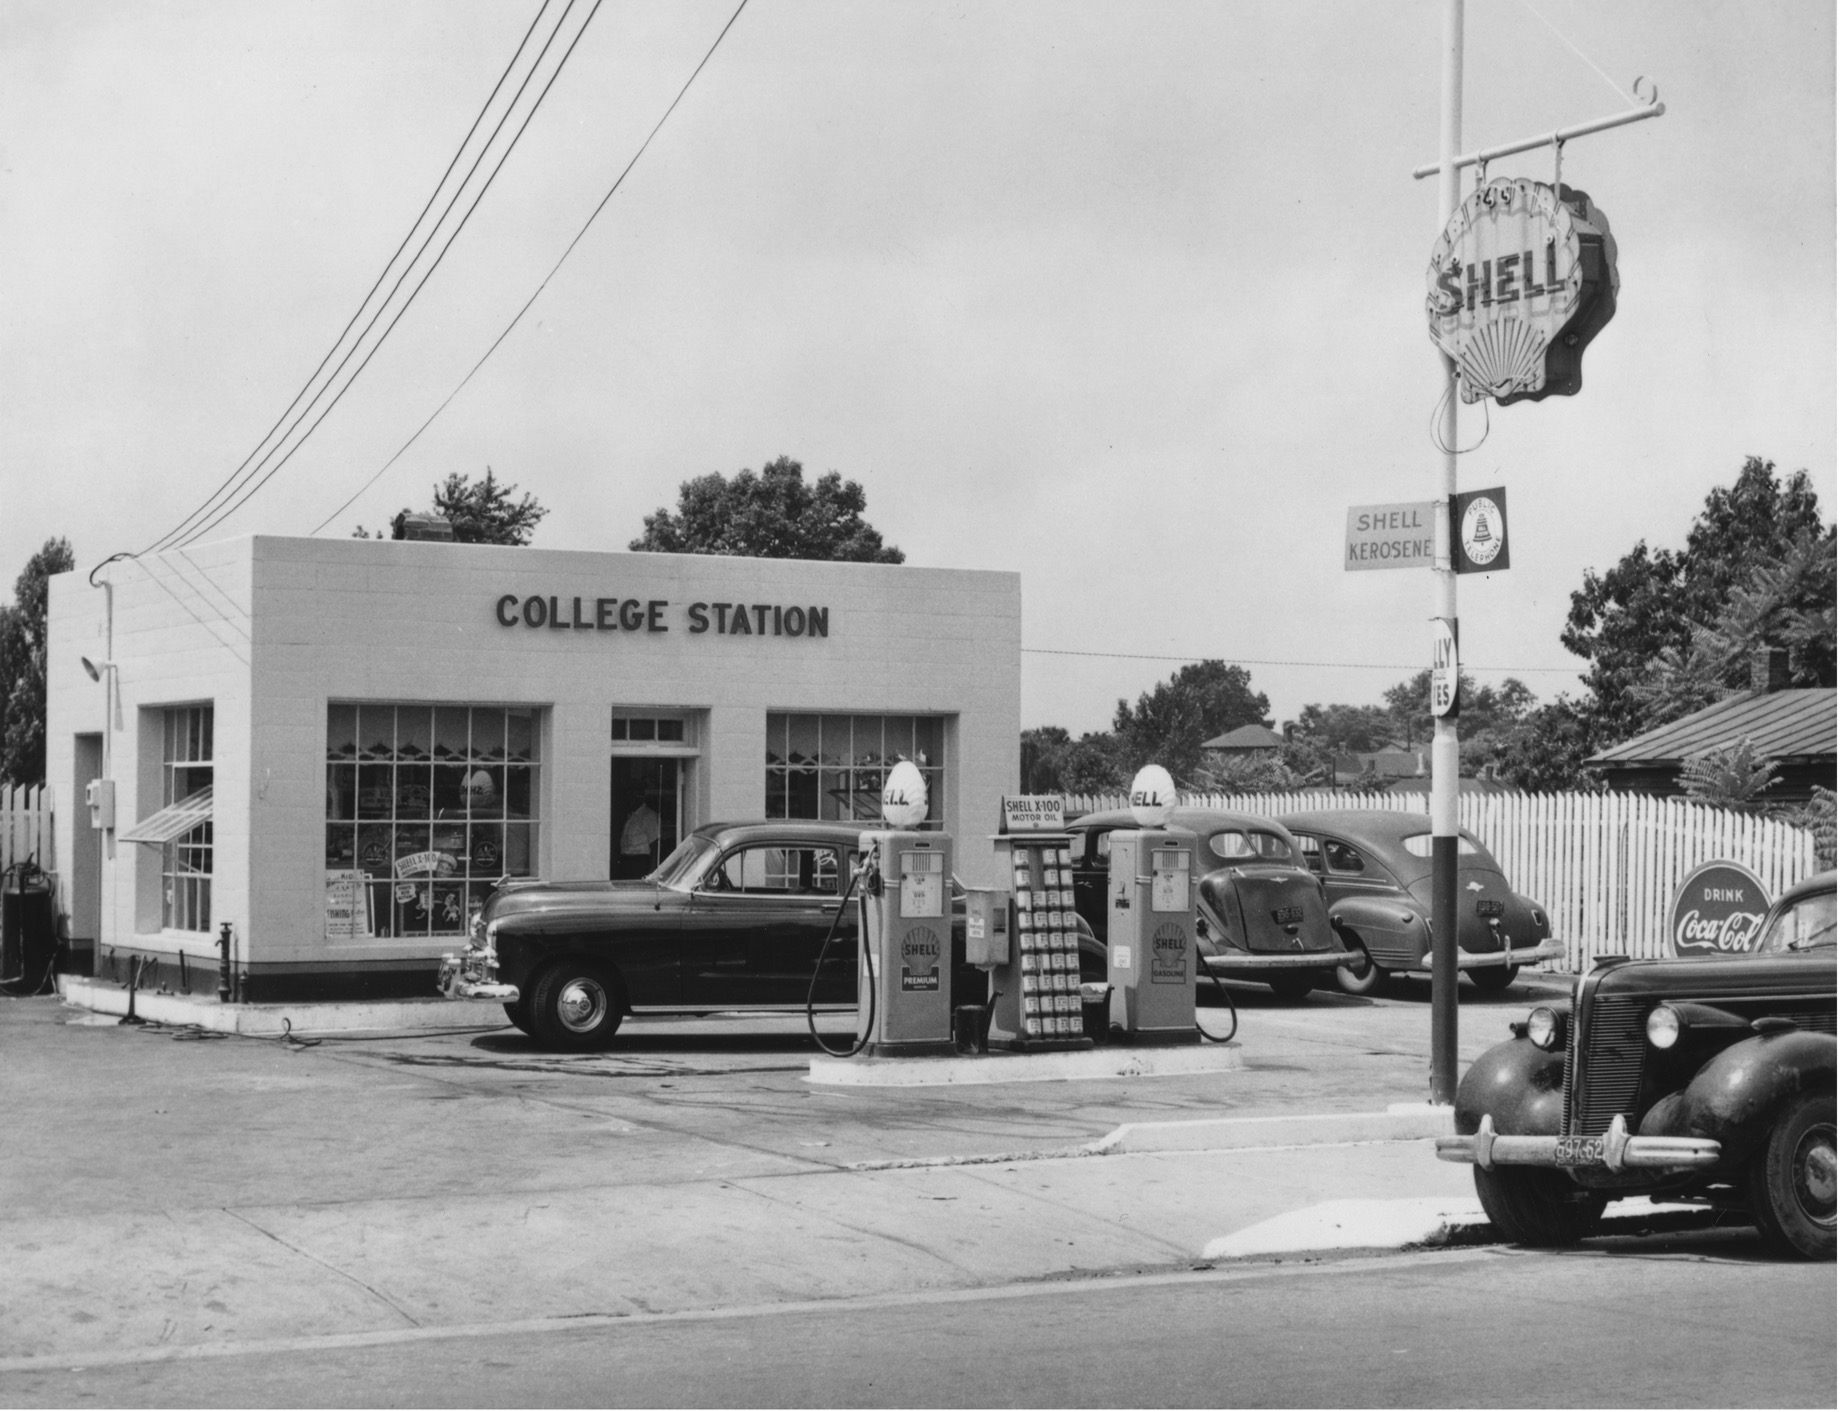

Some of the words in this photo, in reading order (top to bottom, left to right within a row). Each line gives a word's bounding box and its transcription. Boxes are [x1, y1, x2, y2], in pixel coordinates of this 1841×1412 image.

[1436, 246, 1567, 317] SHELL
[1467, 499, 1496, 516] PUBLIC
[1357, 510, 1423, 532] SHELL
[1349, 539, 1432, 562] KEROSENE
[1464, 536, 1502, 562] TELEPHONE
[496, 594, 668, 632] COLLEGE
[687, 602, 829, 637] STATION
[883, 789, 910, 806] ELL
[1131, 791, 1163, 807] ELL
[1006, 801, 1033, 812] SHELL
[1034, 800, 1061, 812] X-100
[397, 856, 418, 871] SHELL
[1704, 888, 1744, 902] DRINK
[1676, 910, 1765, 952] Coca-Col
[904, 944, 938, 956] SHELL
[1155, 939, 1184, 950] SHELL
[903, 976, 938, 985] PREMIUM
[1153, 970, 1184, 978] GASOLINE
